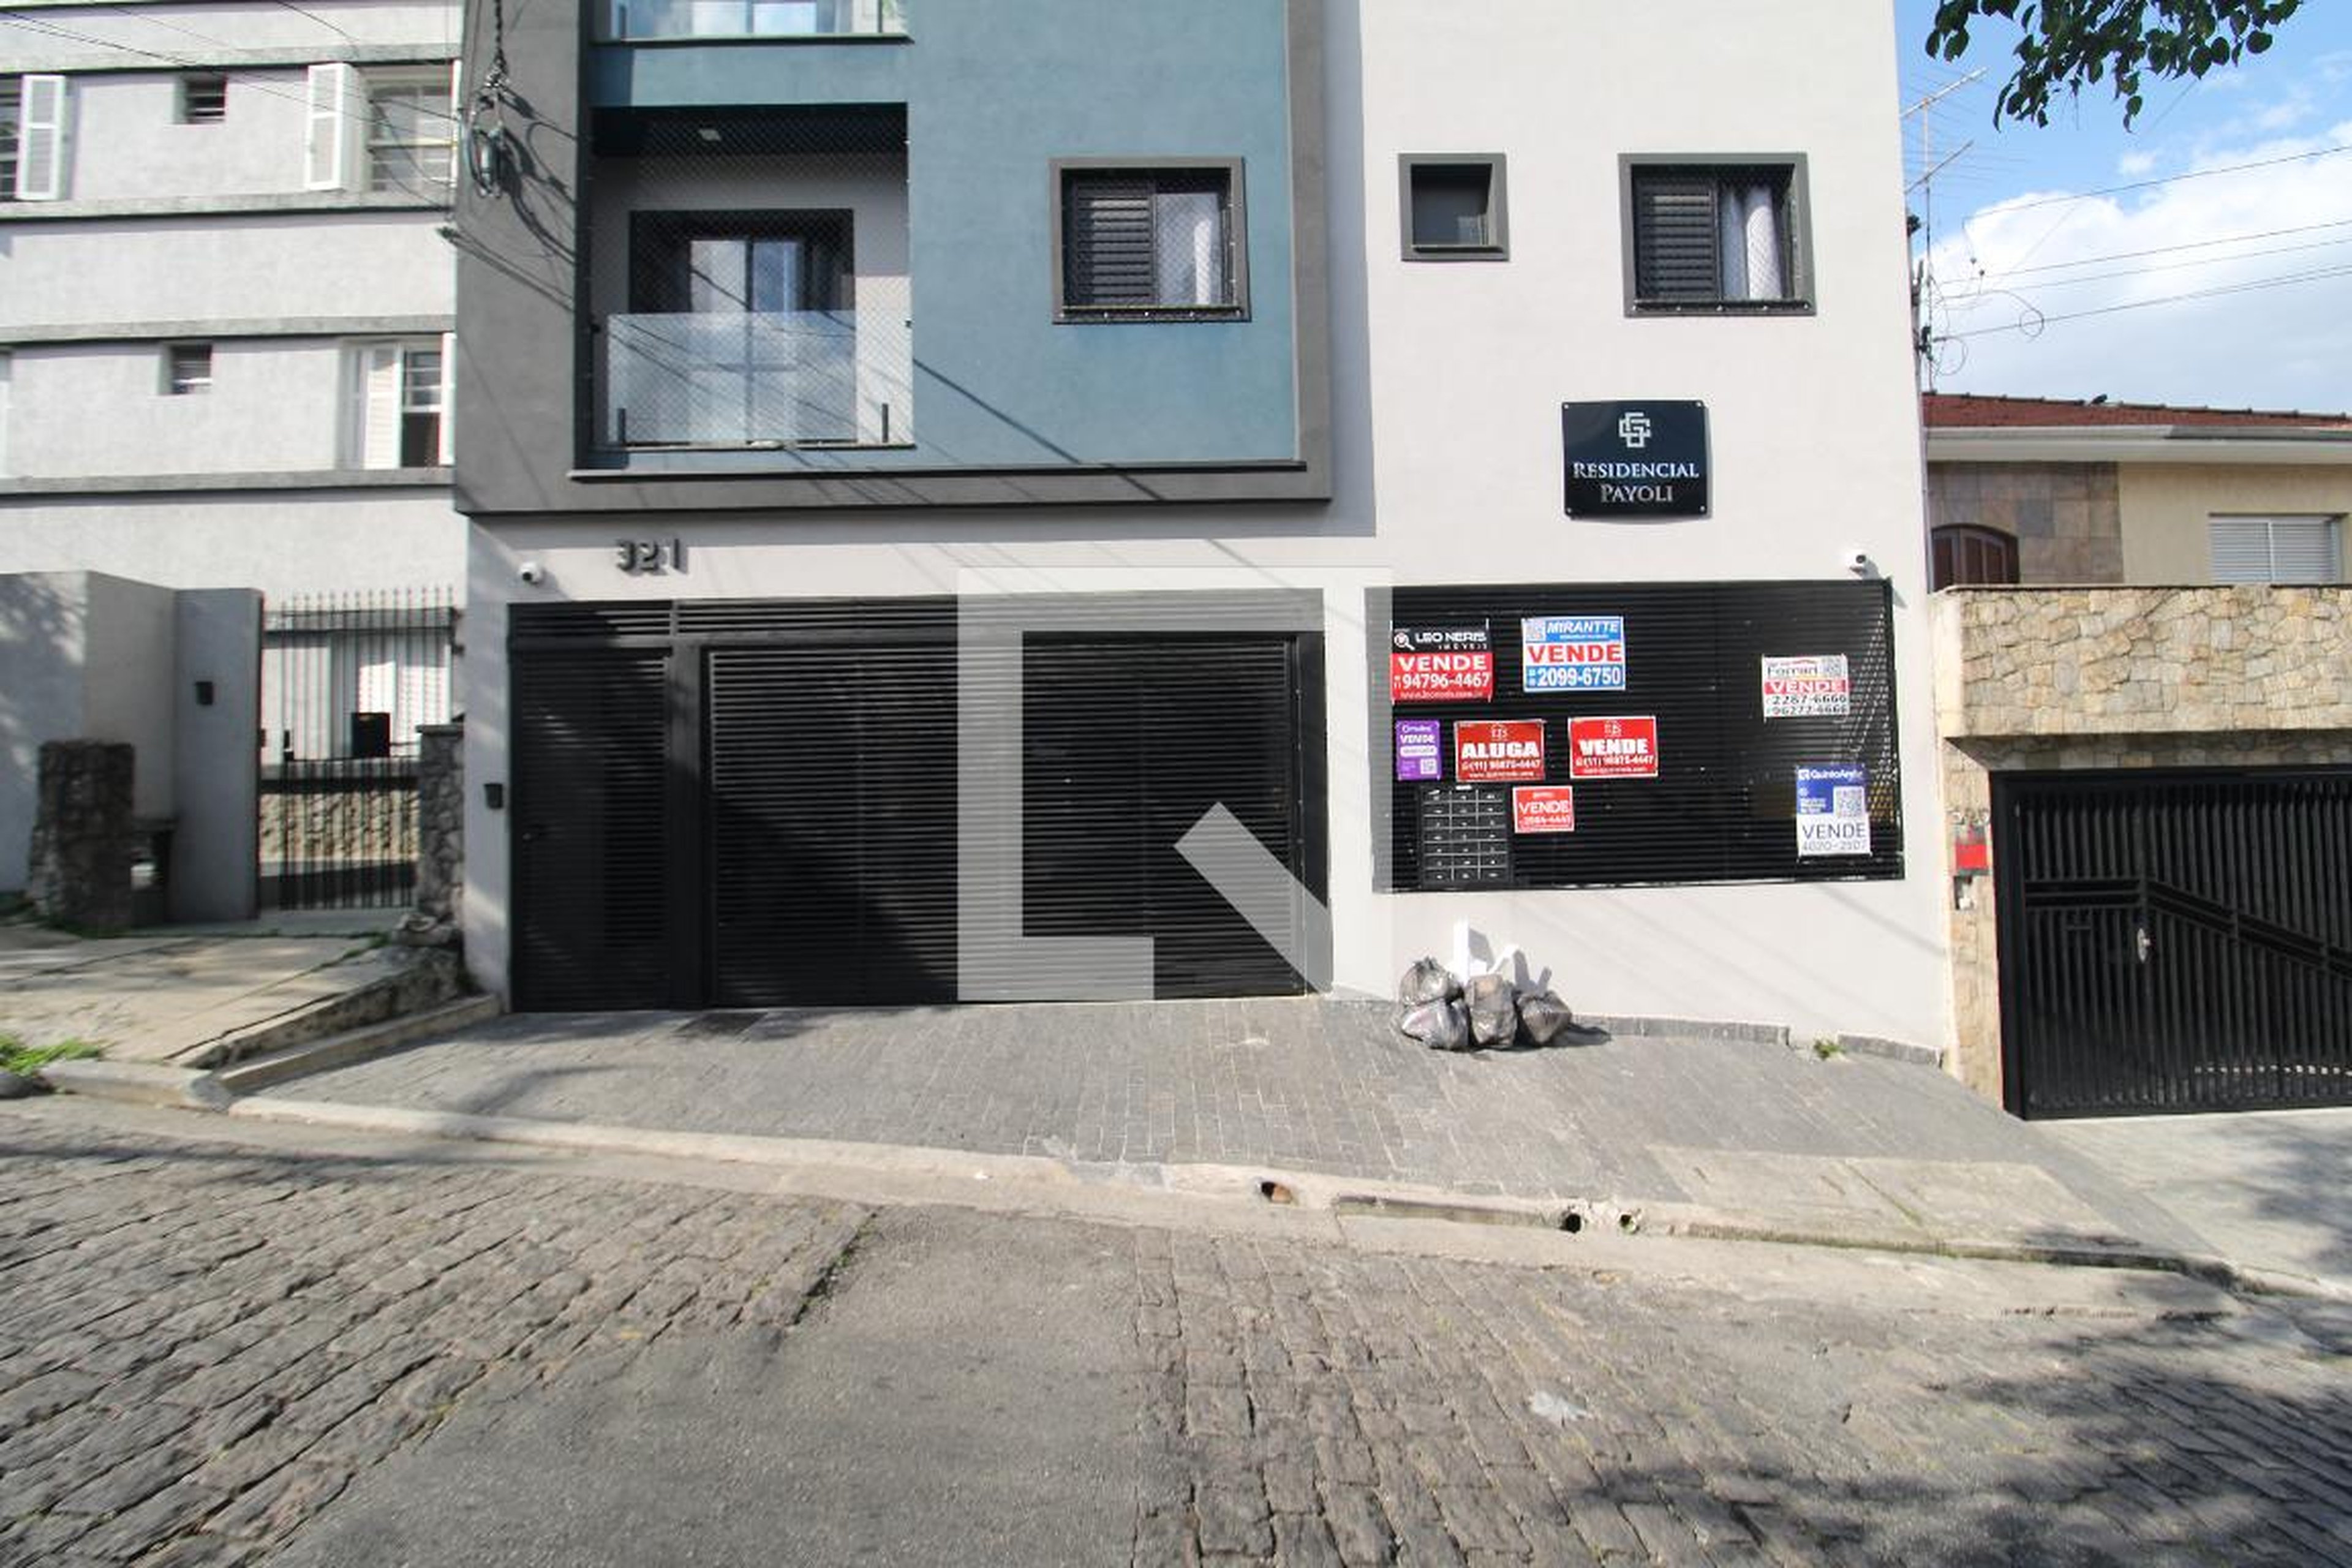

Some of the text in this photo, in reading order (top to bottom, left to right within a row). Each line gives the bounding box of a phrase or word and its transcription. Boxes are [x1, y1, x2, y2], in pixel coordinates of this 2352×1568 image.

[1572, 461, 1700, 478] RESIDENCIAL
[1600, 484, 1673, 502] PAYOLI
[616, 538, 681, 571] 321
[1546, 620, 1619, 634] MIRANTTE
[1415, 631, 1487, 643] LEO NERIS
[1528, 644, 1622, 663] VENDE
[1398, 654, 1487, 672] VENDE
[1402, 672, 1490, 689] 94796-4467
[1537, 666, 1621, 687] 2099-6750
[1770, 679, 1844, 694] VENDE
[1461, 741, 1540, 760] ALUGA
[1578, 737, 1649, 756] VENDE
[1518, 799, 1570, 815] VENDE
[1802, 822, 1866, 839] VENDE
